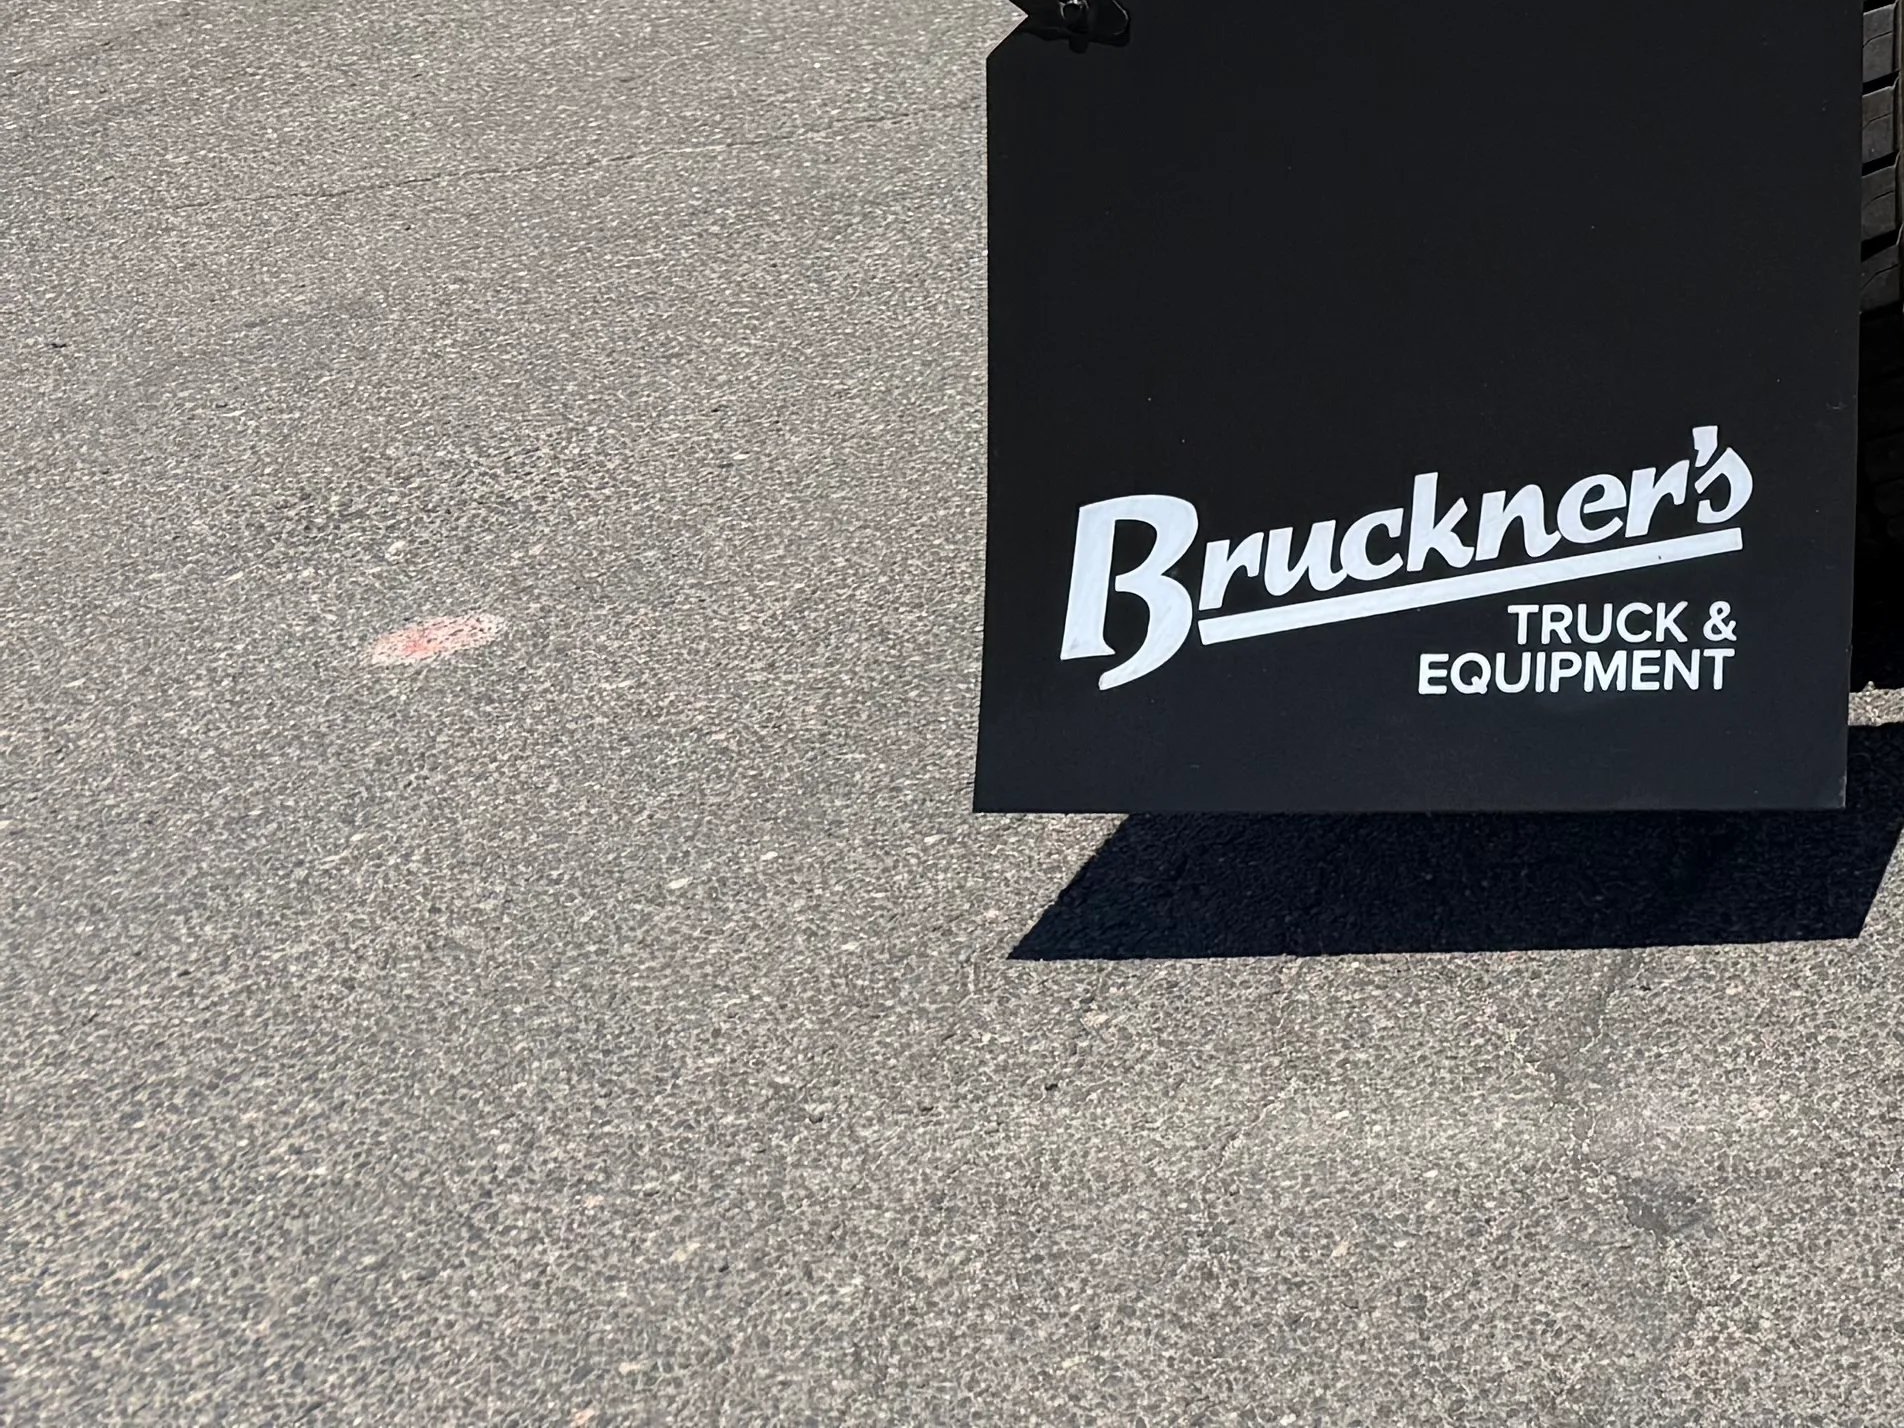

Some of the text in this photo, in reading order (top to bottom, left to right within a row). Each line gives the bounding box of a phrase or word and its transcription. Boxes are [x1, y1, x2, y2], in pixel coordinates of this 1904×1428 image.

[1060, 426, 1753, 691] Bruckner's
[1507, 600, 1737, 646] TRUCK &
[1418, 648, 1736, 695] EQUIPMENT
